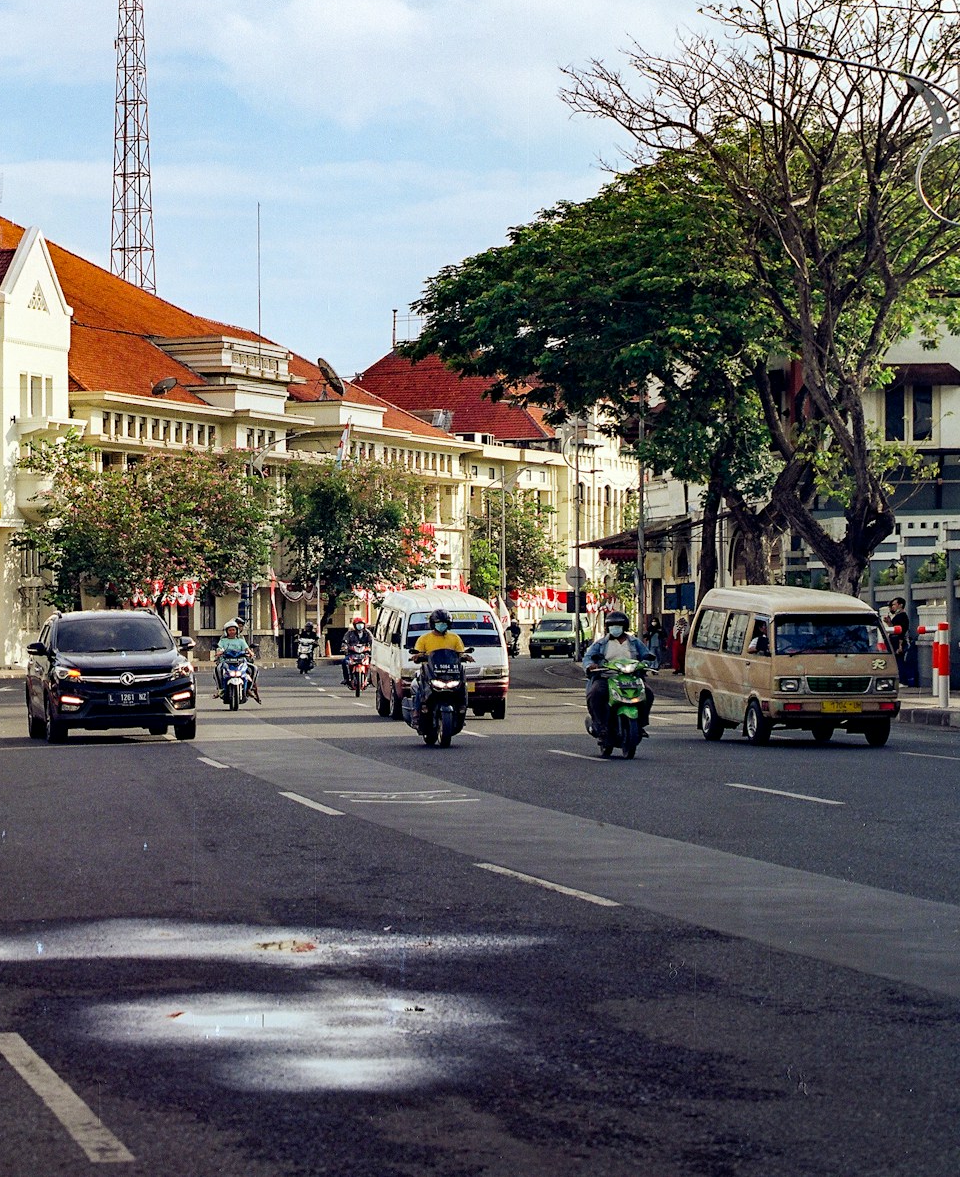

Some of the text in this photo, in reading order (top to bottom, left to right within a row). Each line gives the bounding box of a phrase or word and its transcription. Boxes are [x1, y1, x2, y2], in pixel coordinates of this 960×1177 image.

[483, 615, 491, 624] K
[109, 694, 114, 702] L
[138, 693, 147, 701] NZ
